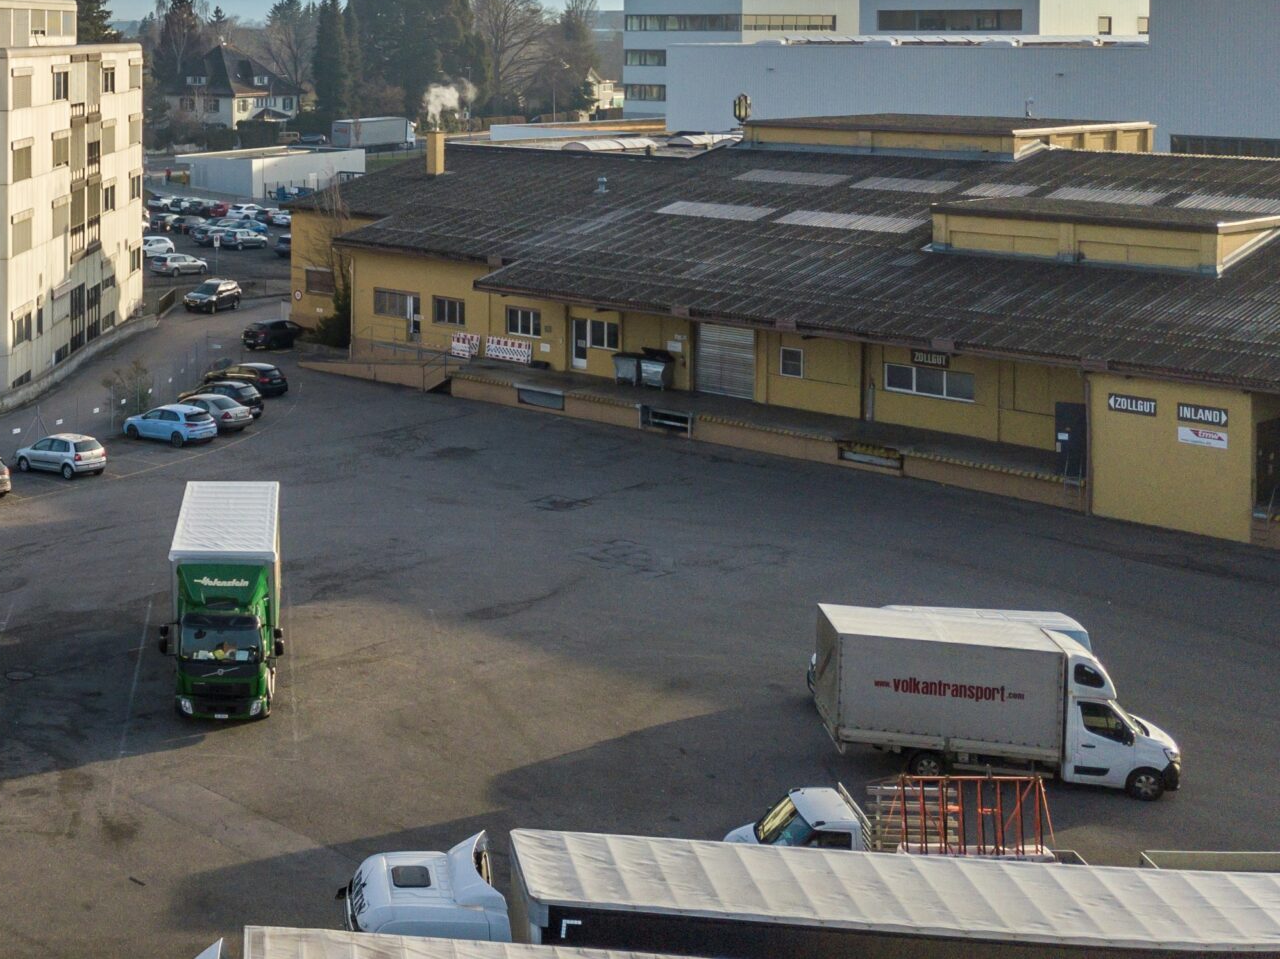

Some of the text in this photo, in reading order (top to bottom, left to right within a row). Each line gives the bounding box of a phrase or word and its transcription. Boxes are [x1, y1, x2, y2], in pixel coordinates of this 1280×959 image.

[913, 351, 946, 366] ZOLLGUT
[1115, 396, 1157, 414] ZOLLGUT
[1179, 405, 1220, 423] INLAND
